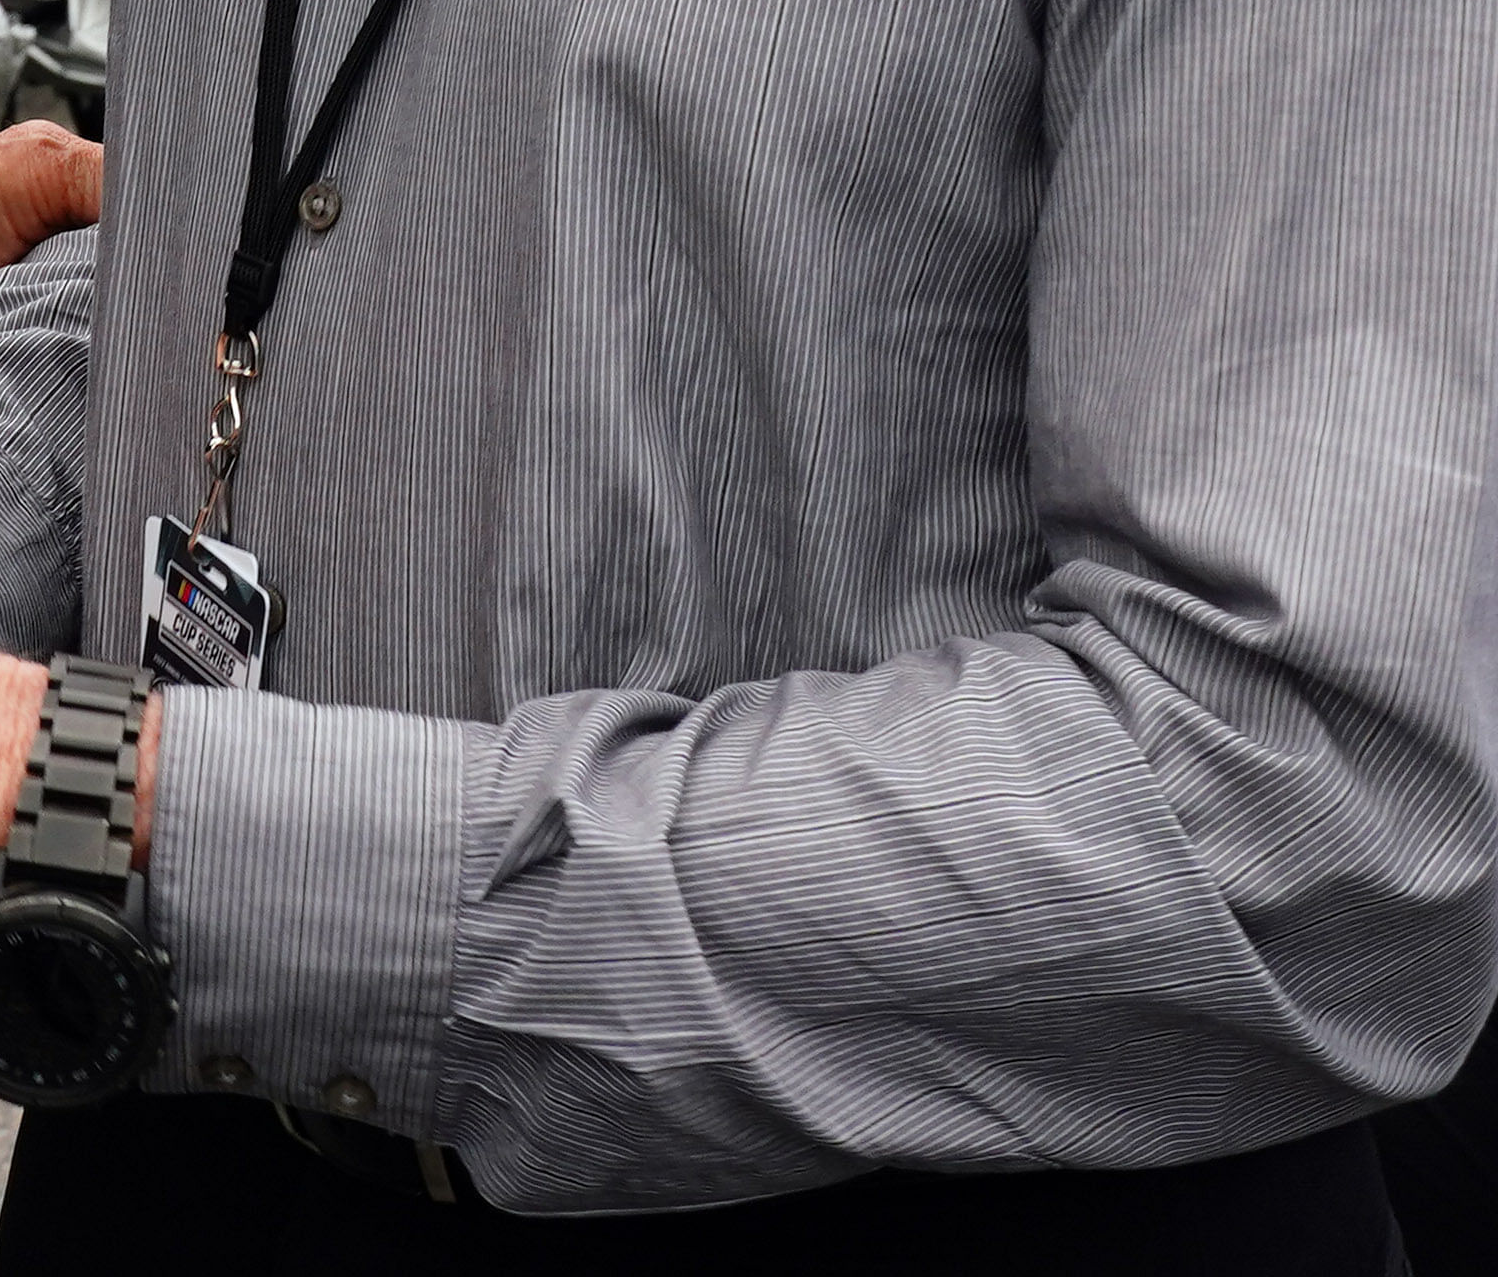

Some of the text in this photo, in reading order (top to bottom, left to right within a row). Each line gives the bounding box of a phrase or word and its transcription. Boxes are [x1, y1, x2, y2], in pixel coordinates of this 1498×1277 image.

[172, 613, 197, 648] CUP
[198, 632, 236, 678] SERIES
[192, 590, 241, 645] NASCAR
